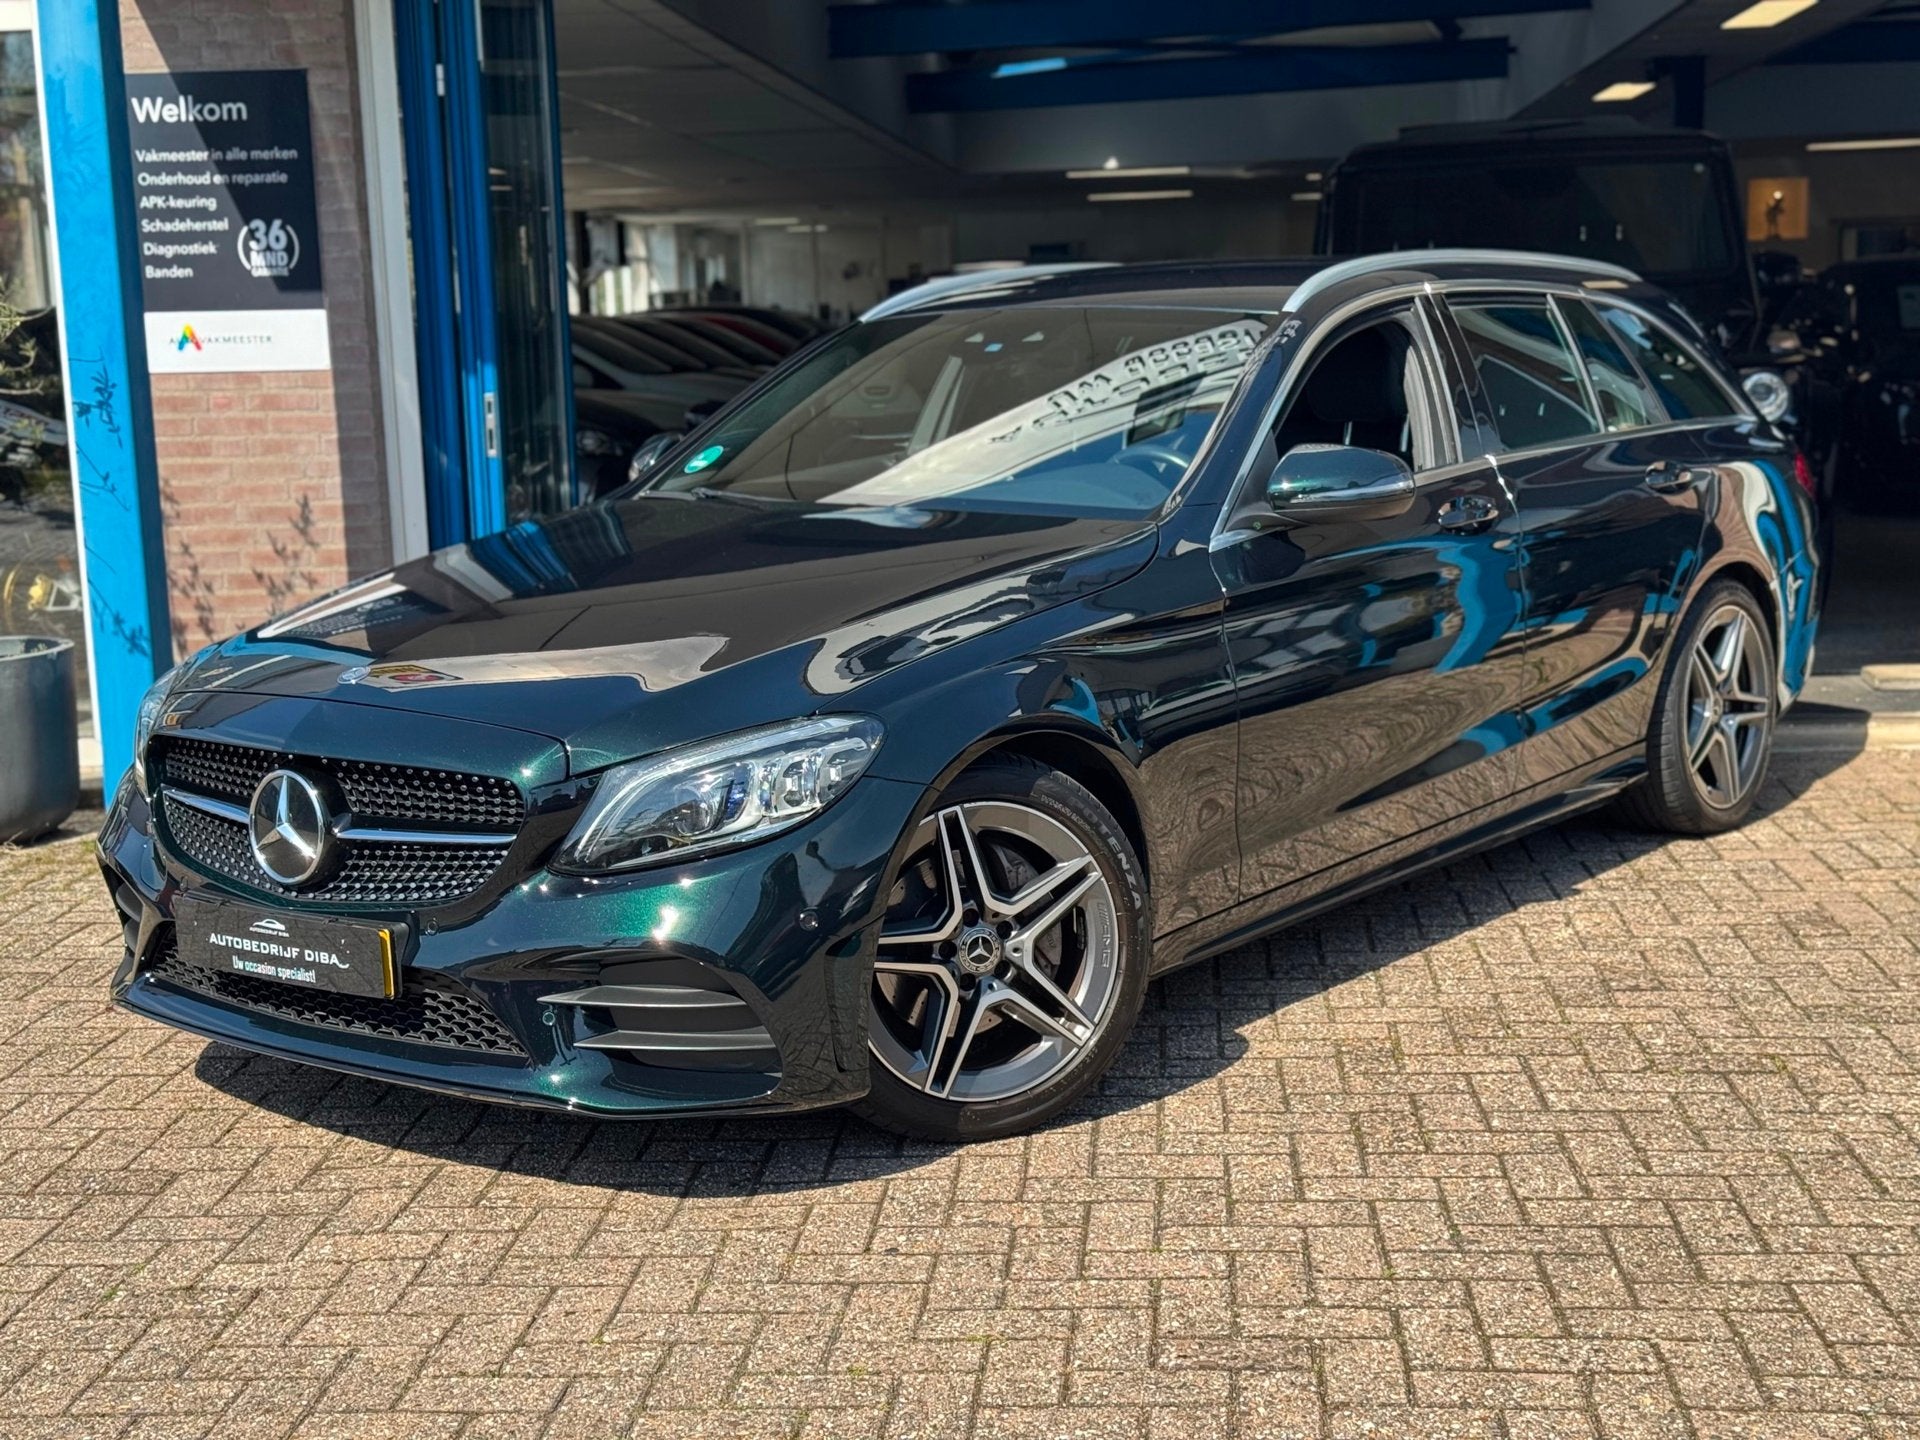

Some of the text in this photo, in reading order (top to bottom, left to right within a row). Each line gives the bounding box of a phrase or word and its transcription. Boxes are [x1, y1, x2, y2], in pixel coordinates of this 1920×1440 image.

[131, 95, 248, 123] Welkom
[135, 146, 298, 163] Vakmeester in alle merken
[137, 171, 288, 187] Onderhoud en reparatie
[140, 196, 217, 211] APK-keuring
[141, 217, 229, 232] Schadeherstel
[249, 218, 288, 250] 36
[143, 241, 217, 258] Diagnostiek
[145, 265, 193, 278] Banden
[209, 932, 349, 969] AUTOBEDRIJF DIBA
[232, 955, 316, 983] Uw occasion specialist!
